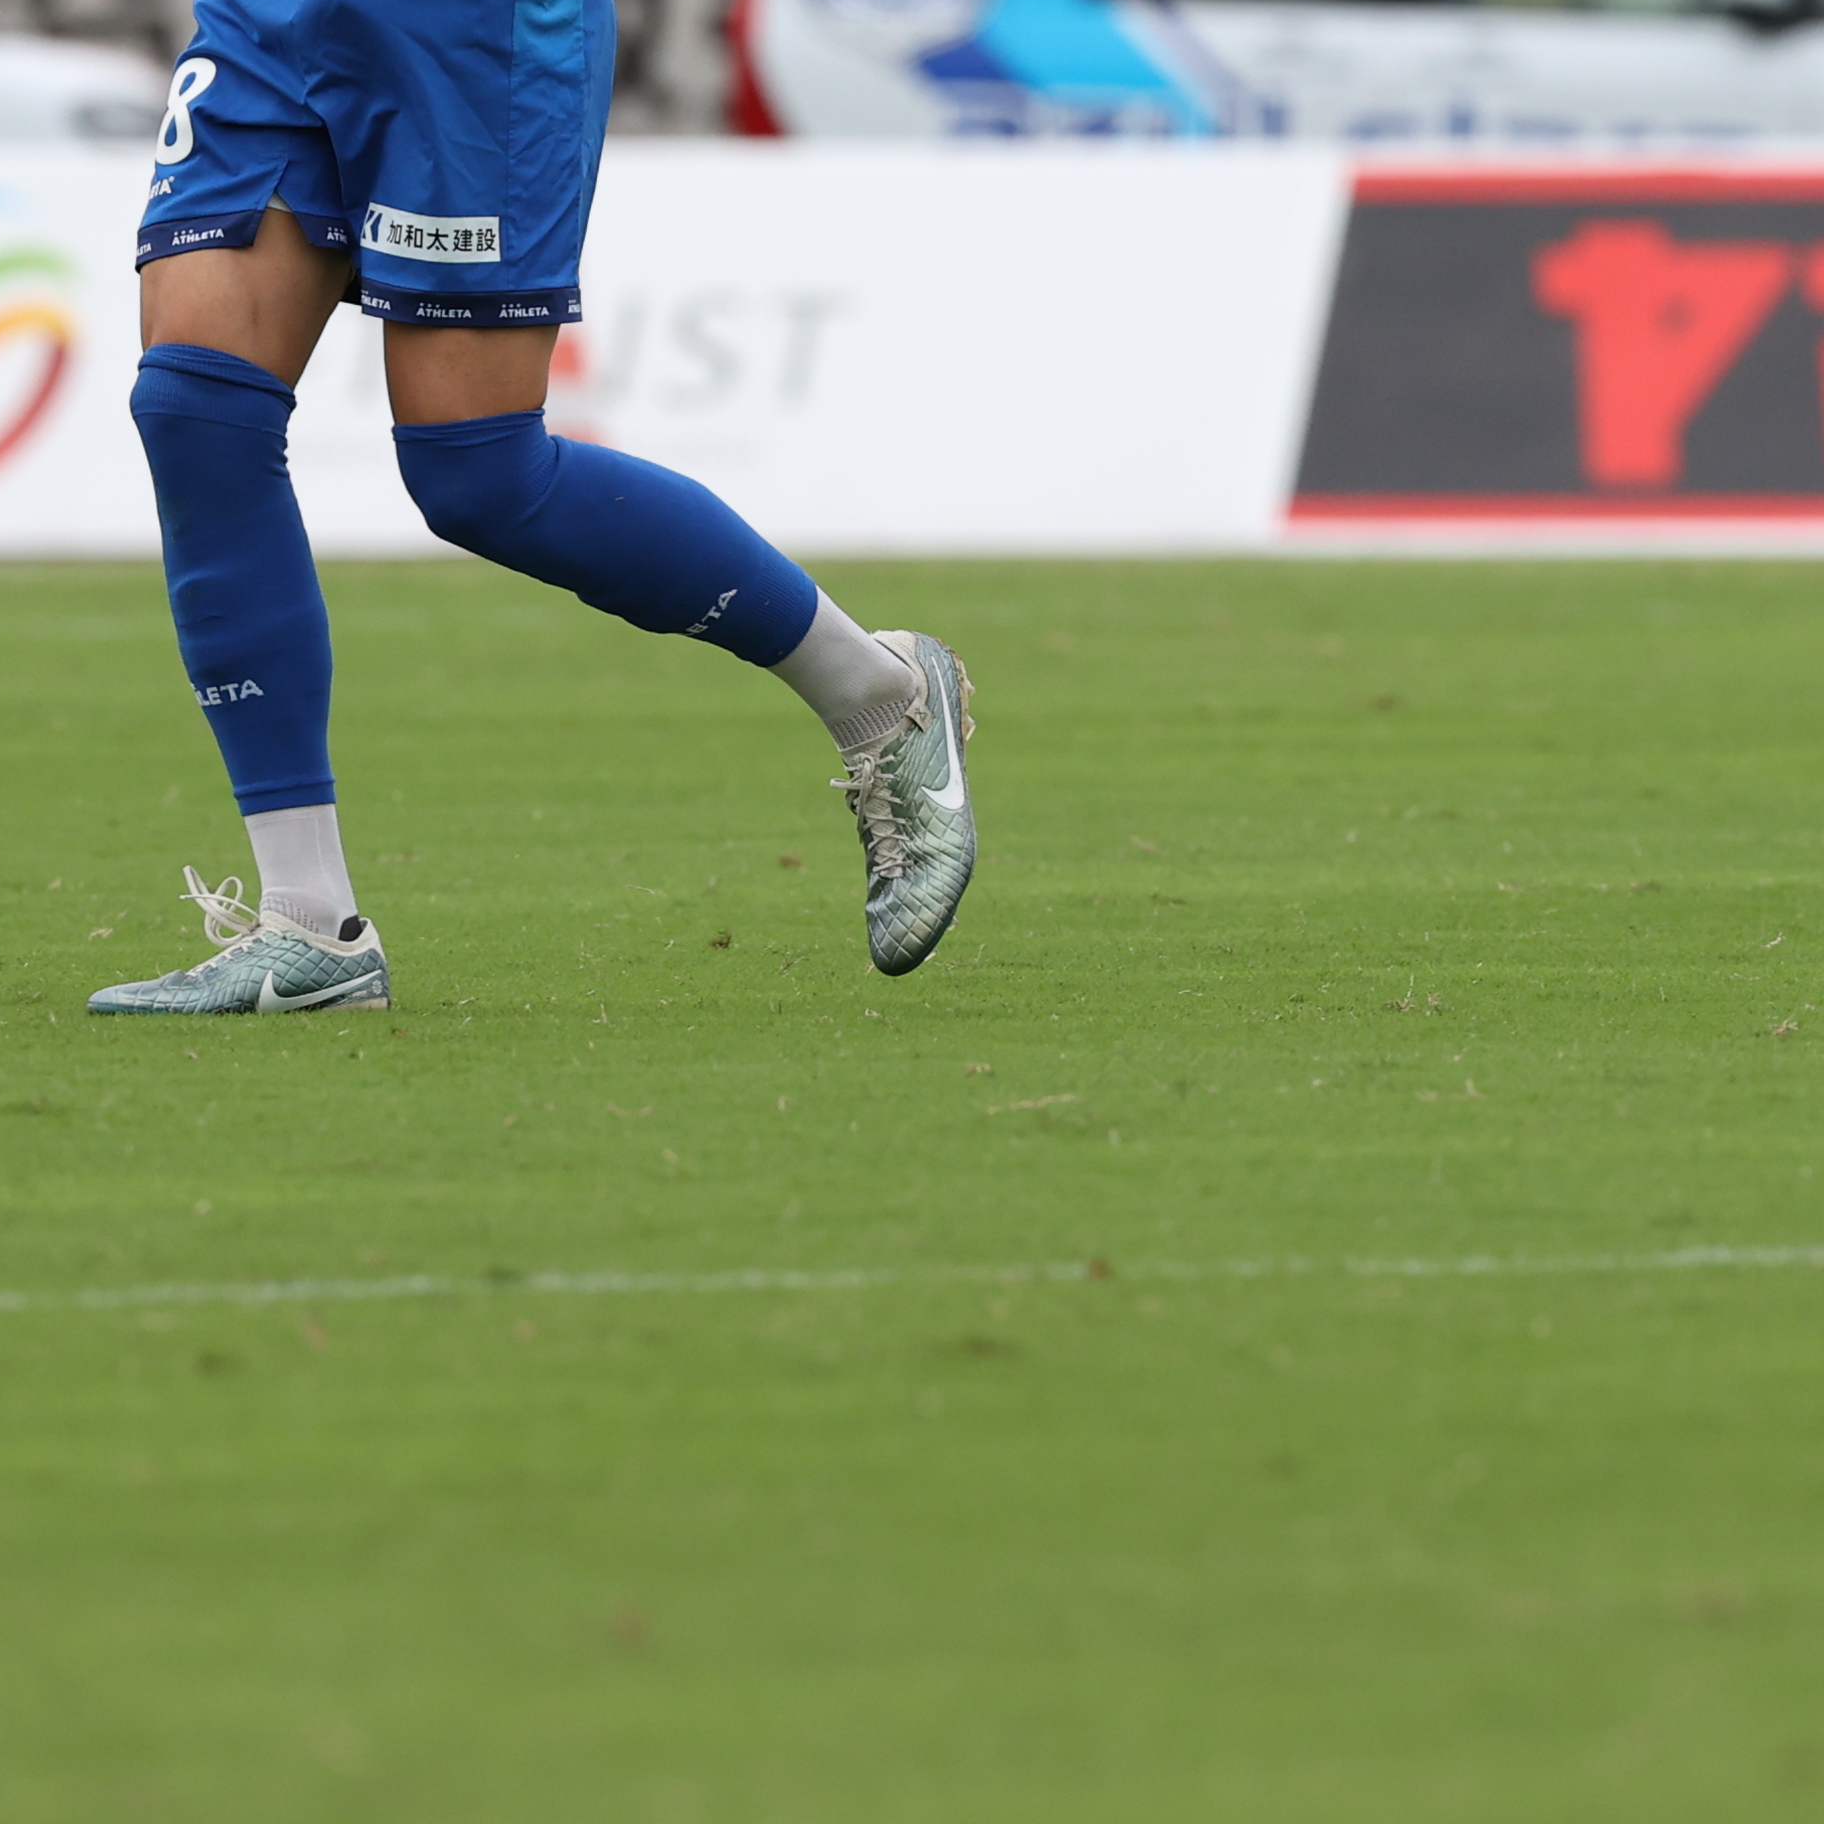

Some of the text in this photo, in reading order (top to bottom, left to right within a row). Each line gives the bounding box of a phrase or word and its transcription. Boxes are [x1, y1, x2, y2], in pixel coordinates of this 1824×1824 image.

[172, 229, 225, 246] ATHLETA
[386, 219, 497, 253] 加和太建設
[416, 304, 472, 319] ATHLETA
[499, 305, 550, 318] ATHLETA
